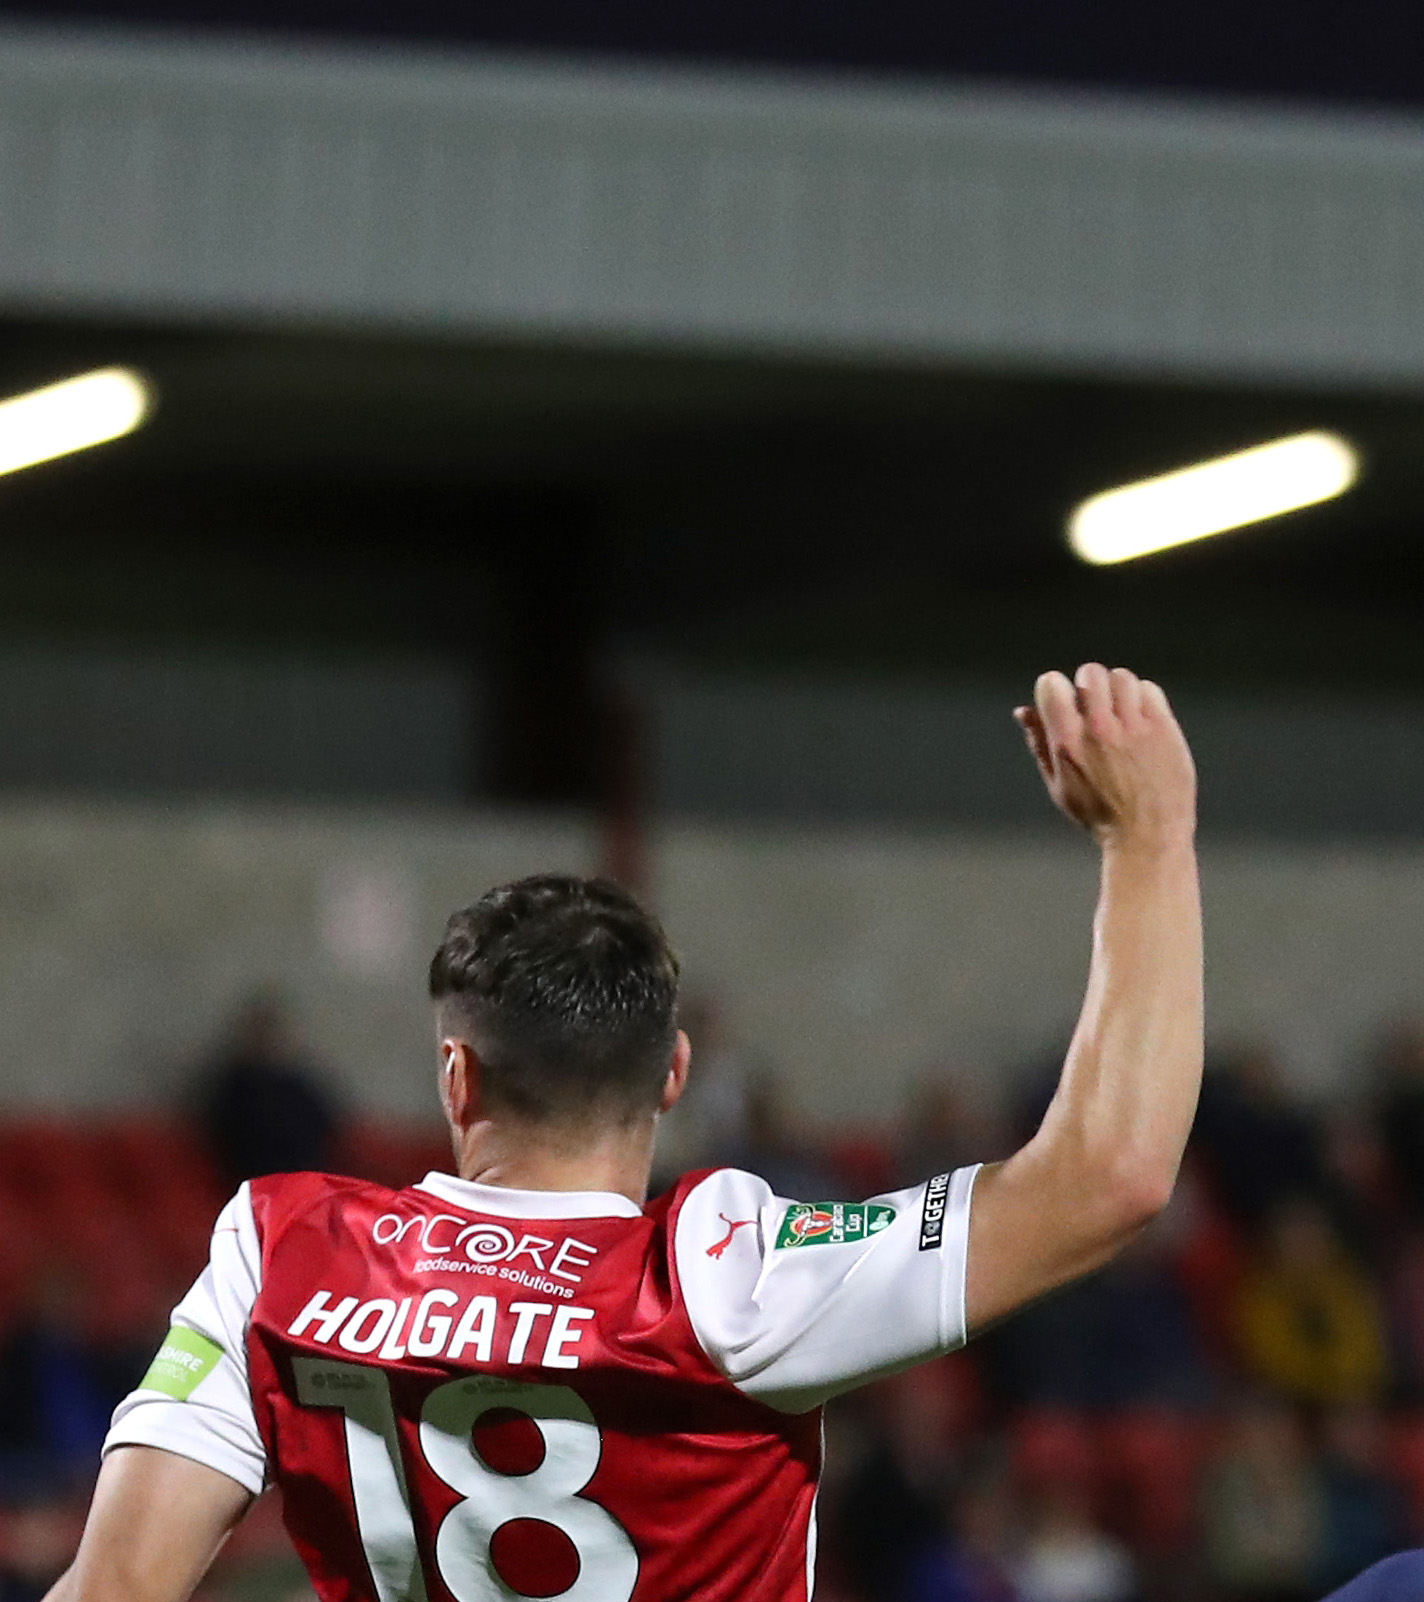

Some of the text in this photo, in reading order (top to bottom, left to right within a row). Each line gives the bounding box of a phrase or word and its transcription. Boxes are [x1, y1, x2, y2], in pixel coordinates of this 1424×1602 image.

[845, 1213, 863, 1232] Cup
[413, 1255, 576, 1299] foodservice solutions
[287, 1288, 596, 1369] HOLGATE
